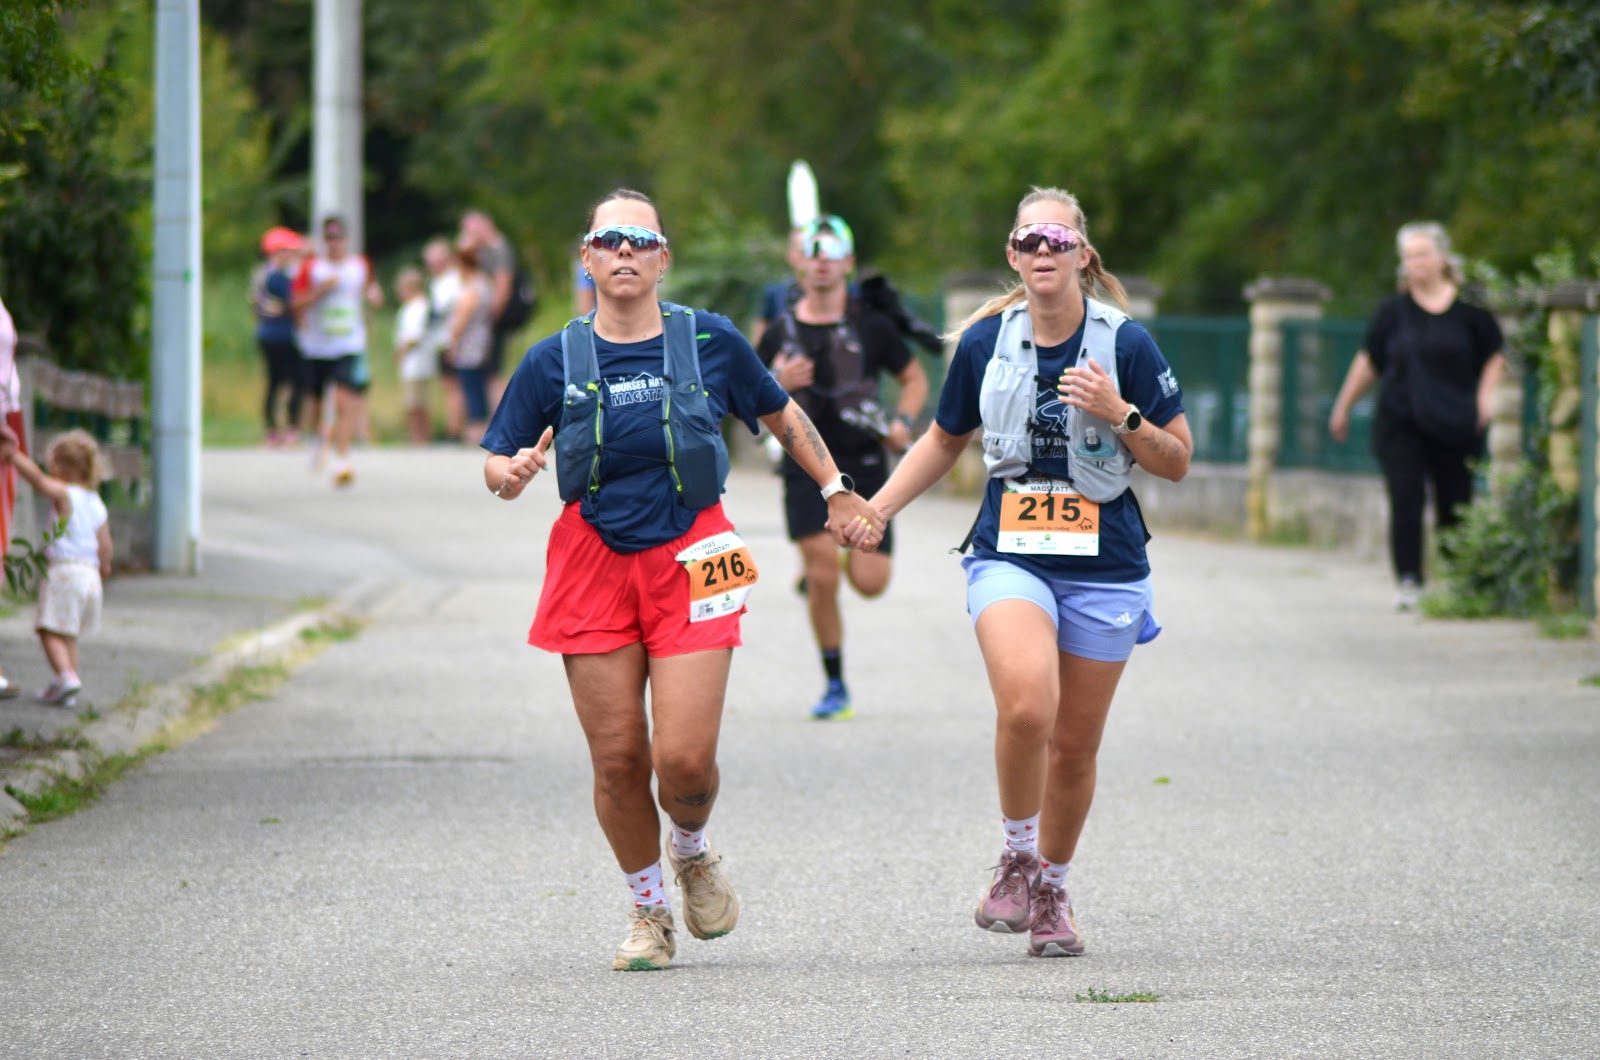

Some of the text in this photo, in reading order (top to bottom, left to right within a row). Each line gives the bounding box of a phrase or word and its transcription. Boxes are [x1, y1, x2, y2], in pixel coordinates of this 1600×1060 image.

[610, 379, 647, 394] COURSES
[1018, 496, 1081, 522] 215
[702, 552, 745, 587] 216
